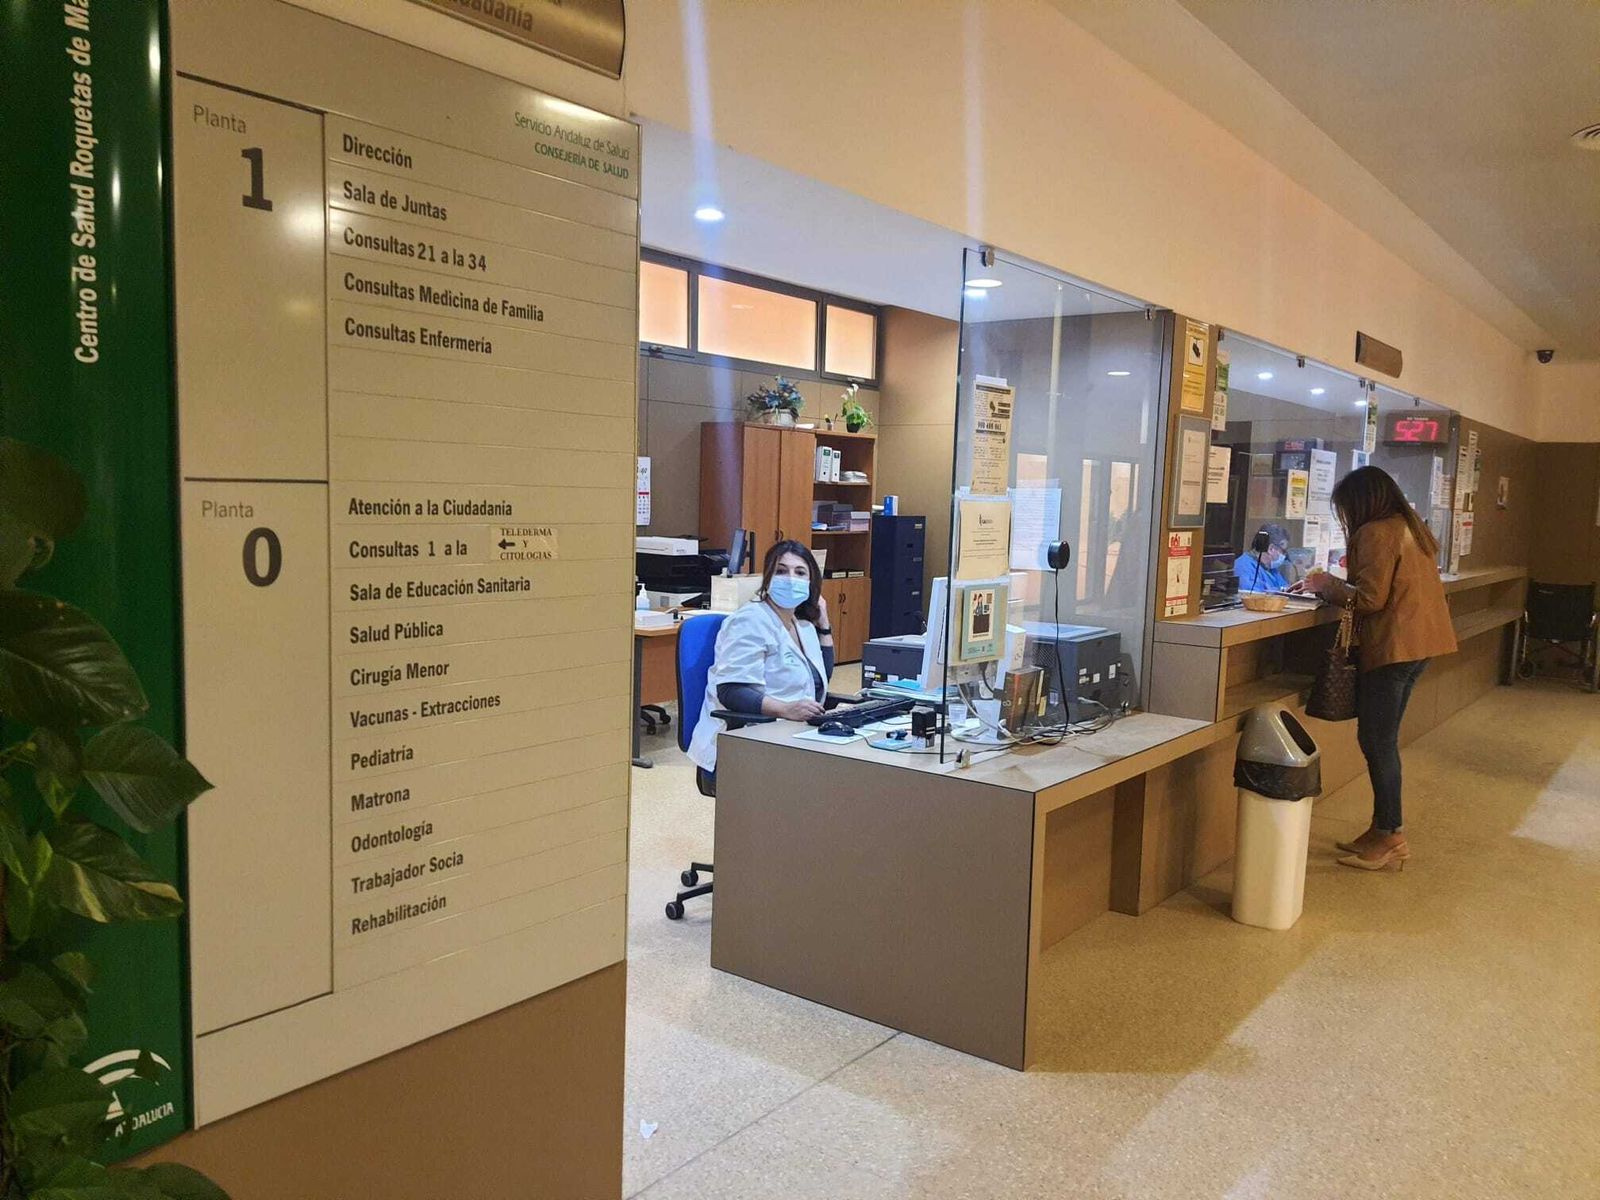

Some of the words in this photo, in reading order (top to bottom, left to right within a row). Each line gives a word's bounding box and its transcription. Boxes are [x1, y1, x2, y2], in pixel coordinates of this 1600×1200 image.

[64, 0, 90, 31] Ma
[65, 36, 91, 66] de
[70, 71, 98, 178] Roquetas
[193, 103, 247, 134] Planta
[514, 112, 552, 136] Servicio
[554, 126, 591, 149] Andaluz
[593, 138, 605, 152] de
[342, 133, 413, 169] Dirección
[240, 147, 273, 212] 1
[588, 158, 600, 171] DE
[603, 162, 629, 179] SALUD
[70, 184, 96, 249] Salud
[343, 180, 376, 205] Sala
[380, 189, 398, 210] de
[401, 194, 447, 222] Juntas
[343, 227, 415, 258] Consultas
[417, 242, 436, 263] 21
[440, 250, 449, 265] a
[452, 248, 465, 267] la
[467, 253, 487, 272] 34
[72, 254, 97, 282] de
[343, 272, 415, 301] Consultas
[419, 284, 479, 312] Medicina
[482, 299, 498, 315] de
[501, 299, 544, 322] Familia
[75, 288, 99, 364] Centro
[344, 317, 416, 344] Consultas
[419, 327, 492, 354] Enfermería
[201, 499, 254, 519] Planta
[348, 497, 411, 516] Atención
[414, 502, 423, 516] a
[427, 499, 439, 516] la
[442, 499, 513, 516] Ciudadanía
[500, 528, 552, 536] TELEDERMA
[242, 527, 283, 588] 0
[349, 540, 419, 559] Consultas
[428, 540, 436, 557] 1
[444, 543, 452, 556] a
[456, 539, 468, 556] la
[500, 551, 552, 560] CITOLOGIAS
[350, 583, 381, 602] Sala
[385, 582, 403, 600] de
[406, 578, 474, 598] Educación
[477, 575, 531, 594] Sanitaria
[349, 624, 390, 644] Salud
[394, 621, 444, 640] Pública
[350, 665, 402, 687] Cirugía
[406, 662, 450, 680] Menor
[349, 708, 409, 728] Vacunas
[420, 695, 501, 718] Extracciones
[351, 744, 414, 771] Pediatría
[351, 788, 410, 812] Matrona
[351, 820, 433, 853] Odontología
[351, 863, 426, 894] Trabajador
[429, 851, 464, 873] Socia
[351, 894, 447, 936] Rehabilitación
[115, 1101, 174, 1137] ADALUCIA
